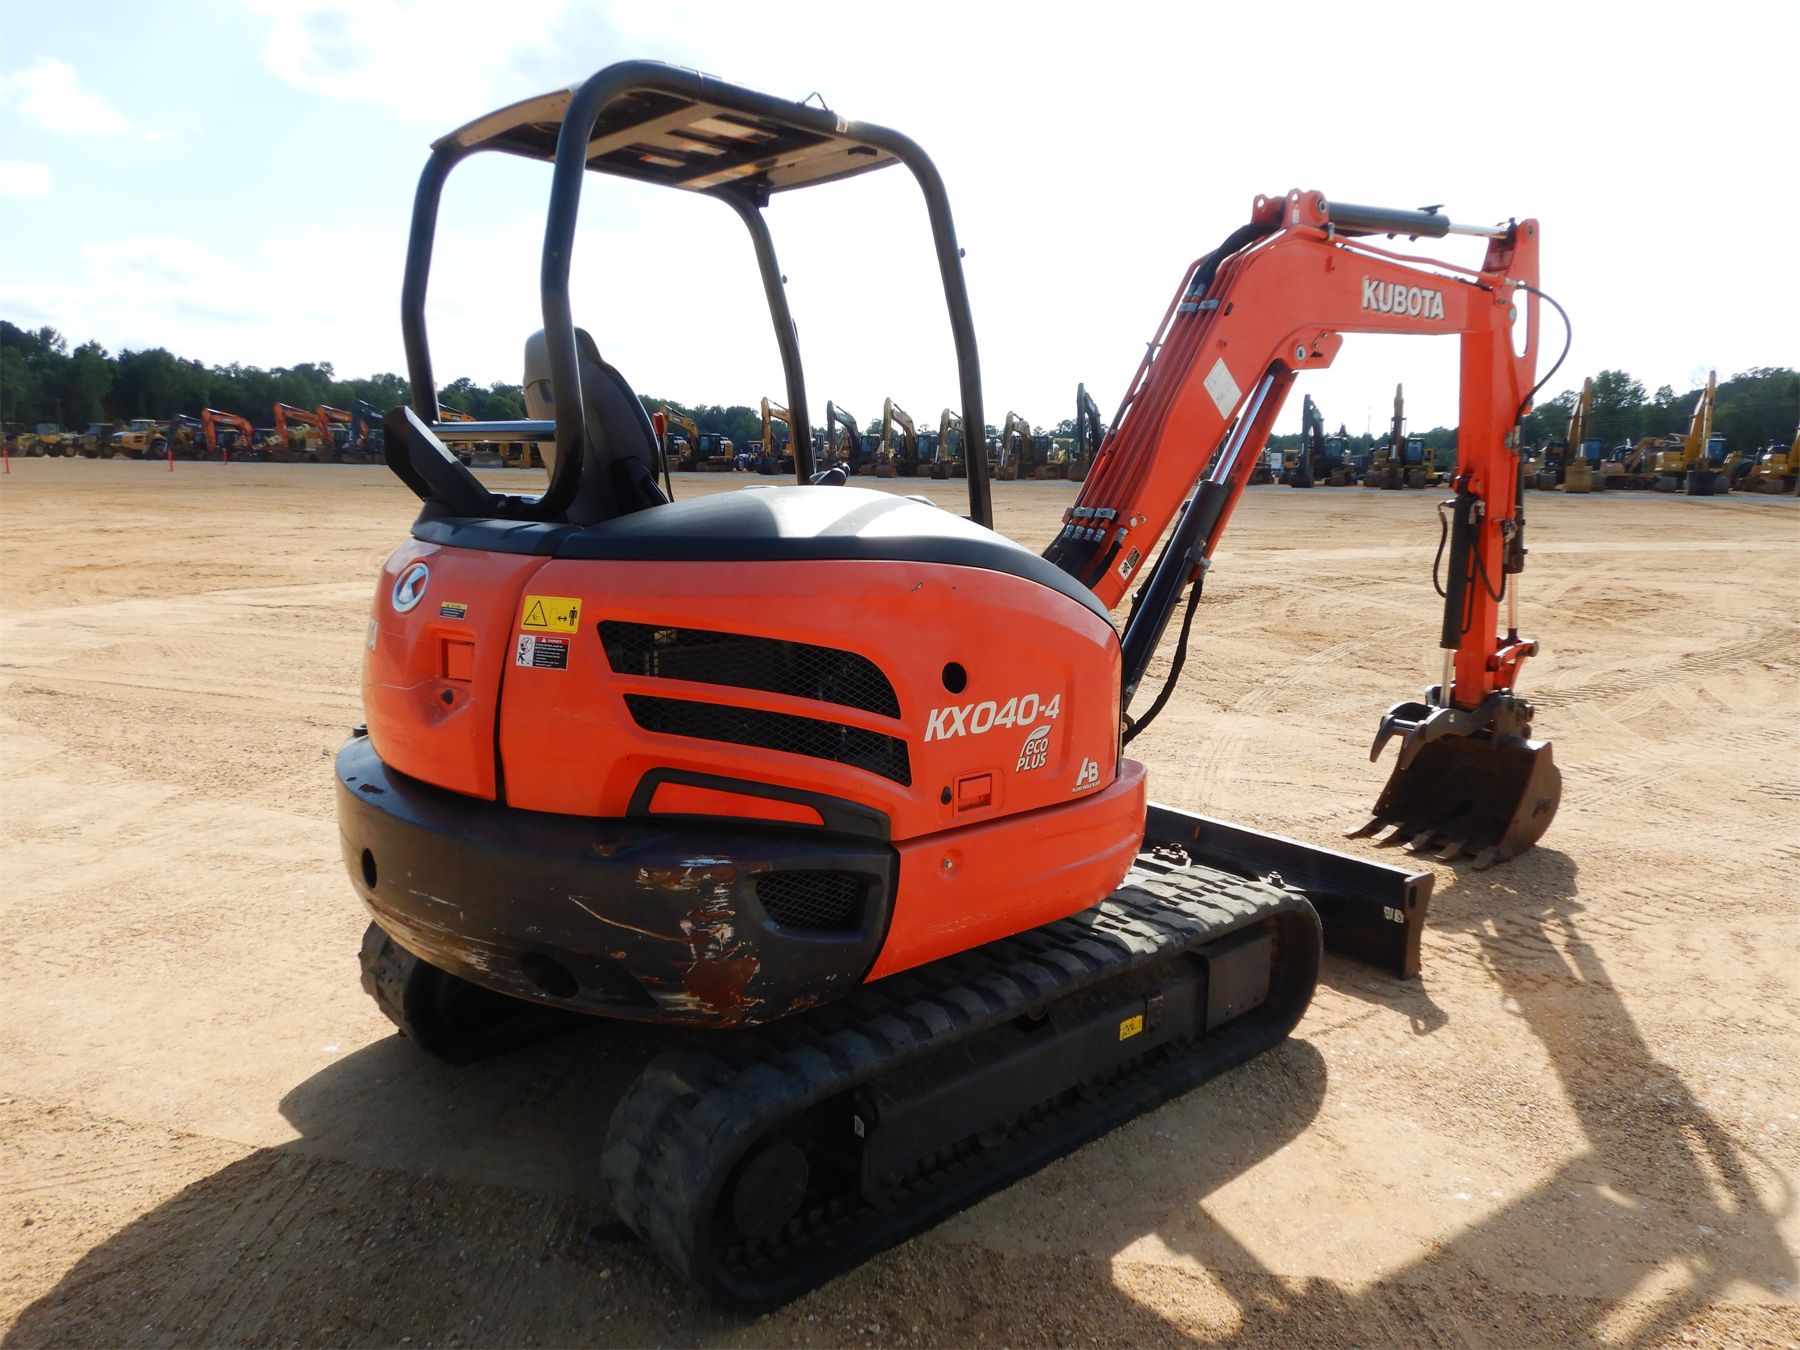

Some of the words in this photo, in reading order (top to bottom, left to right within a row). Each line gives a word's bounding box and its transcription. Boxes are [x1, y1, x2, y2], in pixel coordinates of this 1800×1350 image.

[1362, 278, 1445, 320] KUBOTA
[924, 693, 1060, 742] KX040-4
[1026, 739, 1048, 755] eco
[1016, 754, 1047, 772] PLUS
